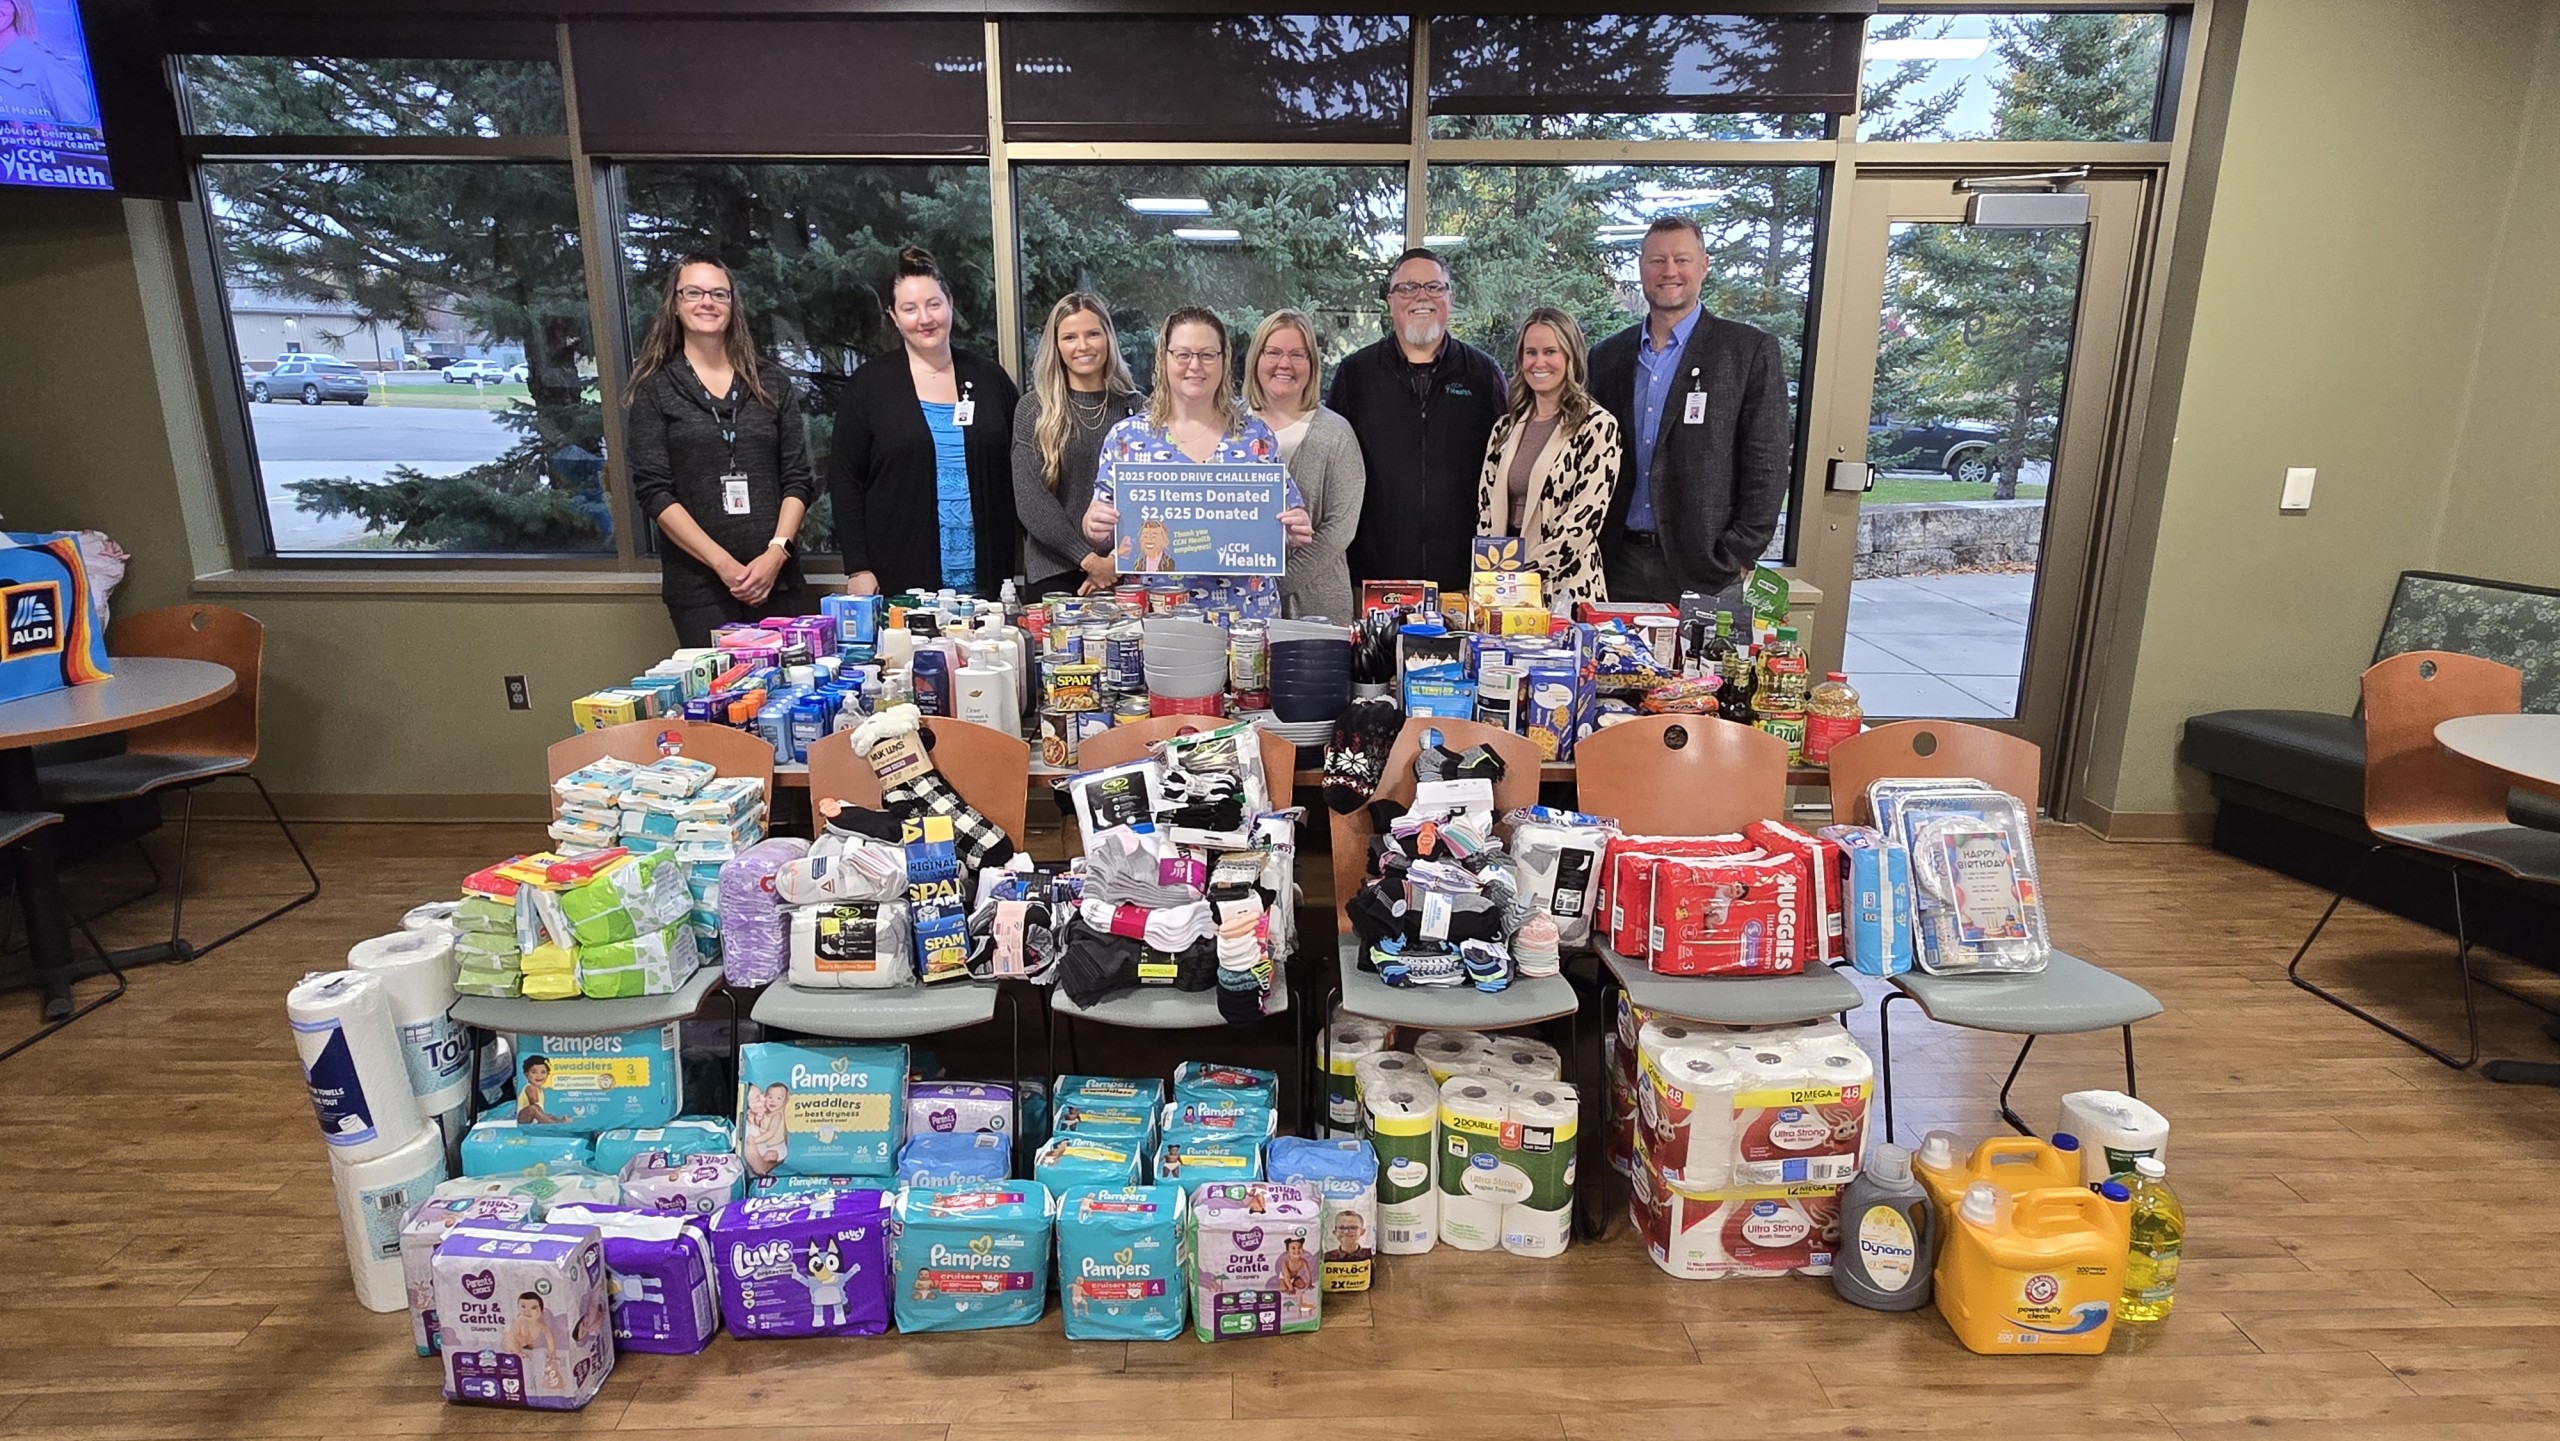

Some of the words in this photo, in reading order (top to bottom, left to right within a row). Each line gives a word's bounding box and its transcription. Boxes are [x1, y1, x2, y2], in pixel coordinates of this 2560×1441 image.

[11, 106, 52, 117] Health
[0, 124, 19, 135] you
[22, 126, 39, 136] for
[41, 127, 74, 140] being
[75, 132, 91, 140] an
[2, 137, 26, 146] part
[28, 137, 41, 146] of
[43, 140, 63, 148] our
[65, 141, 100, 151] team!
[17, 149, 56, 164] CCM
[16, 162, 106, 186] Health
[1119, 472, 1145, 482] 2025
[1147, 472, 1178, 482] FOOD
[1182, 472, 1213, 482] DRIVE
[1215, 472, 1281, 483] CHALLENGE
[1129, 489, 1157, 502] 625
[1160, 489, 1203, 503] Items
[1206, 489, 1270, 503] Donated
[1141, 506, 1191, 522] $2,625
[1195, 507, 1259, 521] Donated
[1173, 530, 1195, 538] Thank
[1196, 529, 1208, 537] you
[1188, 535, 1211, 543] Health
[1174, 543, 1212, 553] employees!
[1228, 543, 1250, 553] CCM
[1225, 553, 1277, 567] Health
[12, 626, 53, 645] ALDI
[1057, 675, 1092, 686] SPAM
[870, 749, 885, 762] MUK
[1963, 849, 1995, 858] HAPPY
[910, 858, 957, 872] RIGINAL
[1957, 859, 2006, 869] BIRTHDAY
[1766, 913, 1776, 935] little
[1774, 873, 1797, 970] HUGGIES
[924, 931, 966, 951] SPAM
[553, 1061, 612, 1070] swaddlers
[626, 1064, 634, 1074] 3
[791, 1063, 868, 1091] Pampers
[1086, 1079, 1135, 1089] Pampers
[319, 1088, 345, 1096] TOWELS
[1667, 1088, 1682, 1100] 48
[1790, 1092, 1803, 1102] 12
[1804, 1090, 1833, 1099] MEGA
[1842, 1087, 1860, 1099] 48
[794, 1098, 861, 1109] swaddlers
[1198, 1102, 1245, 1117] Pampers
[1453, 1117, 1461, 1127] 2
[1461, 1118, 1494, 1129] DOUBLE
[1505, 1125, 1516, 1139] 4
[1774, 1130, 1795, 1138] Ultra
[1797, 1129, 1826, 1139] Strong
[856, 1145, 868, 1153] 26
[877, 1142, 888, 1155] 3
[1186, 1147, 1230, 1156] Pampers
[789, 1177, 828, 1187] Pampers
[1470, 1174, 1491, 1184] Ultra
[1493, 1177, 1523, 1190] Strong
[1474, 1184, 1494, 1193] Paper
[1495, 1186, 1517, 1195] Towels
[1098, 1189, 1147, 1203] Pampers
[1748, 1225, 1770, 1234] Ultra
[1772, 1224, 1804, 1236] Strong
[1861, 1239, 1912, 1260] Dynamo
[733, 1242, 792, 1277] Luvs
[930, 1243, 1011, 1270] Pampers
[1230, 1254, 1253, 1264] Dry
[1257, 1254, 1266, 1263] &
[1082, 1257, 1150, 1279] Pampers
[1226, 1264, 1269, 1273] Gentle
[465, 1277, 493, 1289] Parent's
[1016, 1276, 1024, 1285] 3
[1152, 1283, 1159, 1291] 4
[461, 1302, 487, 1314] Dry
[491, 1302, 501, 1313] &
[2018, 1306, 2062, 1315] powerfully
[460, 1314, 506, 1325] Gentle
[747, 1315, 756, 1324] 3
[1241, 1316, 1252, 1330] 5
[1997, 1333, 2014, 1341] 200
[482, 1380, 496, 1397] 3
